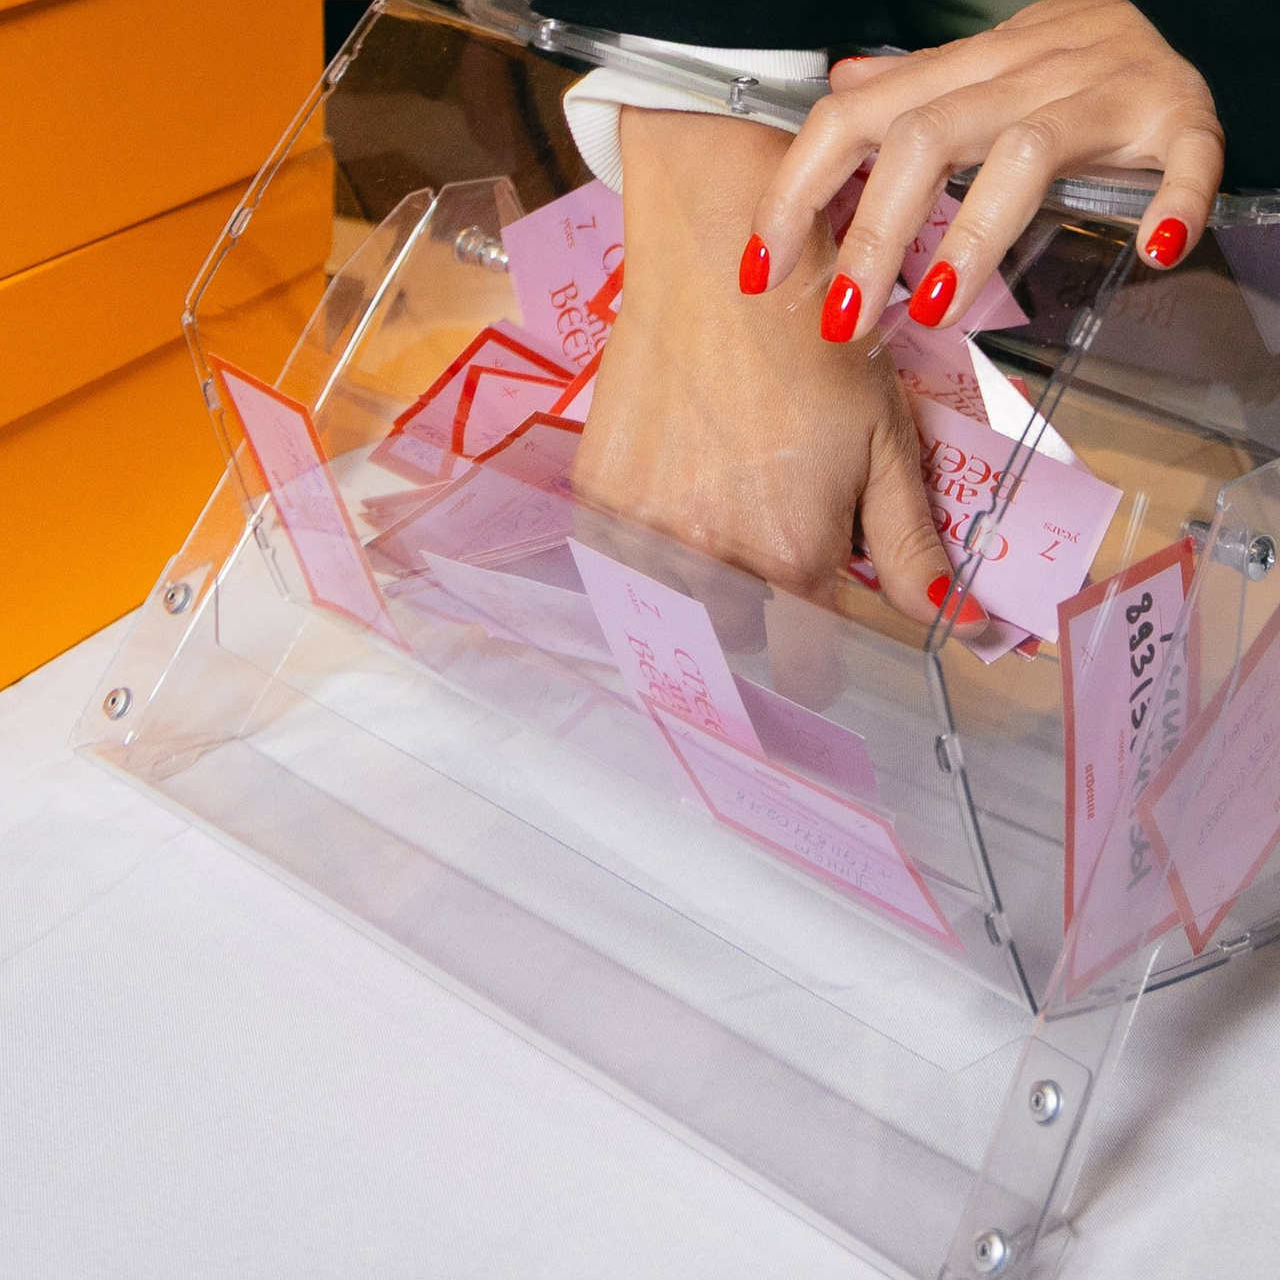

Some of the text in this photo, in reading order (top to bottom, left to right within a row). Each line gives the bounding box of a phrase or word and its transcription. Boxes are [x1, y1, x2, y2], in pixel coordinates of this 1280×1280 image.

[558, 216, 576, 250] years
[576, 215, 599, 231] 7
[1043, 521, 1081, 544] years
[1038, 540, 1061, 562] 7
[640, 599, 662, 620] 7
